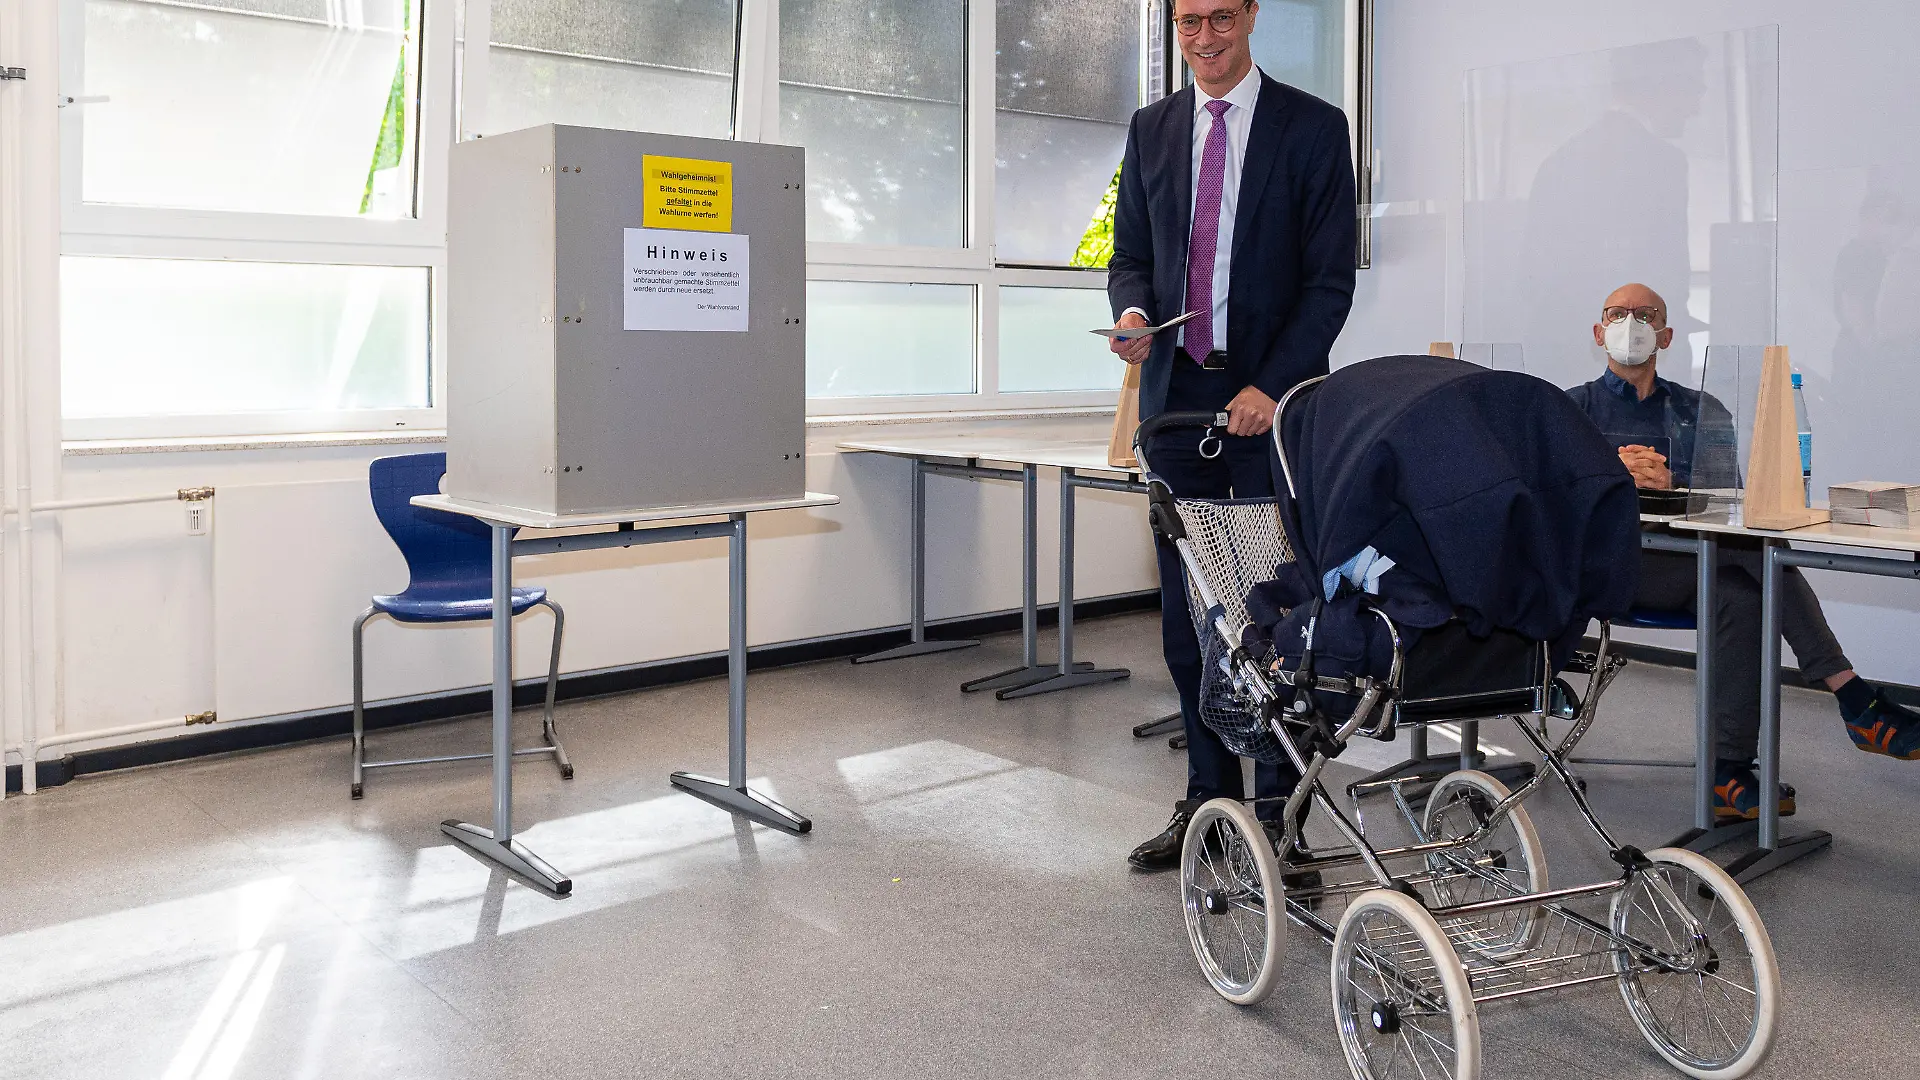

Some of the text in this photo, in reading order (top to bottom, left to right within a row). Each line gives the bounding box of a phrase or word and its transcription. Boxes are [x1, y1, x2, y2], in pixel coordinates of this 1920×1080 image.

[660, 170, 717, 183] Wahlgeheimnis!
[659, 185, 718, 197] Bitte Stimmzettel
[666, 197, 692, 207] gefaltet
[701, 199, 713, 207] die
[659, 207, 719, 219] Wahlurne werfen!
[647, 245, 728, 262] Hinweis
[633, 267, 740, 278] Verschriebene oder versehentlich
[673, 278, 704, 286] gemachte
[705, 279, 740, 287] Stimmzettel
